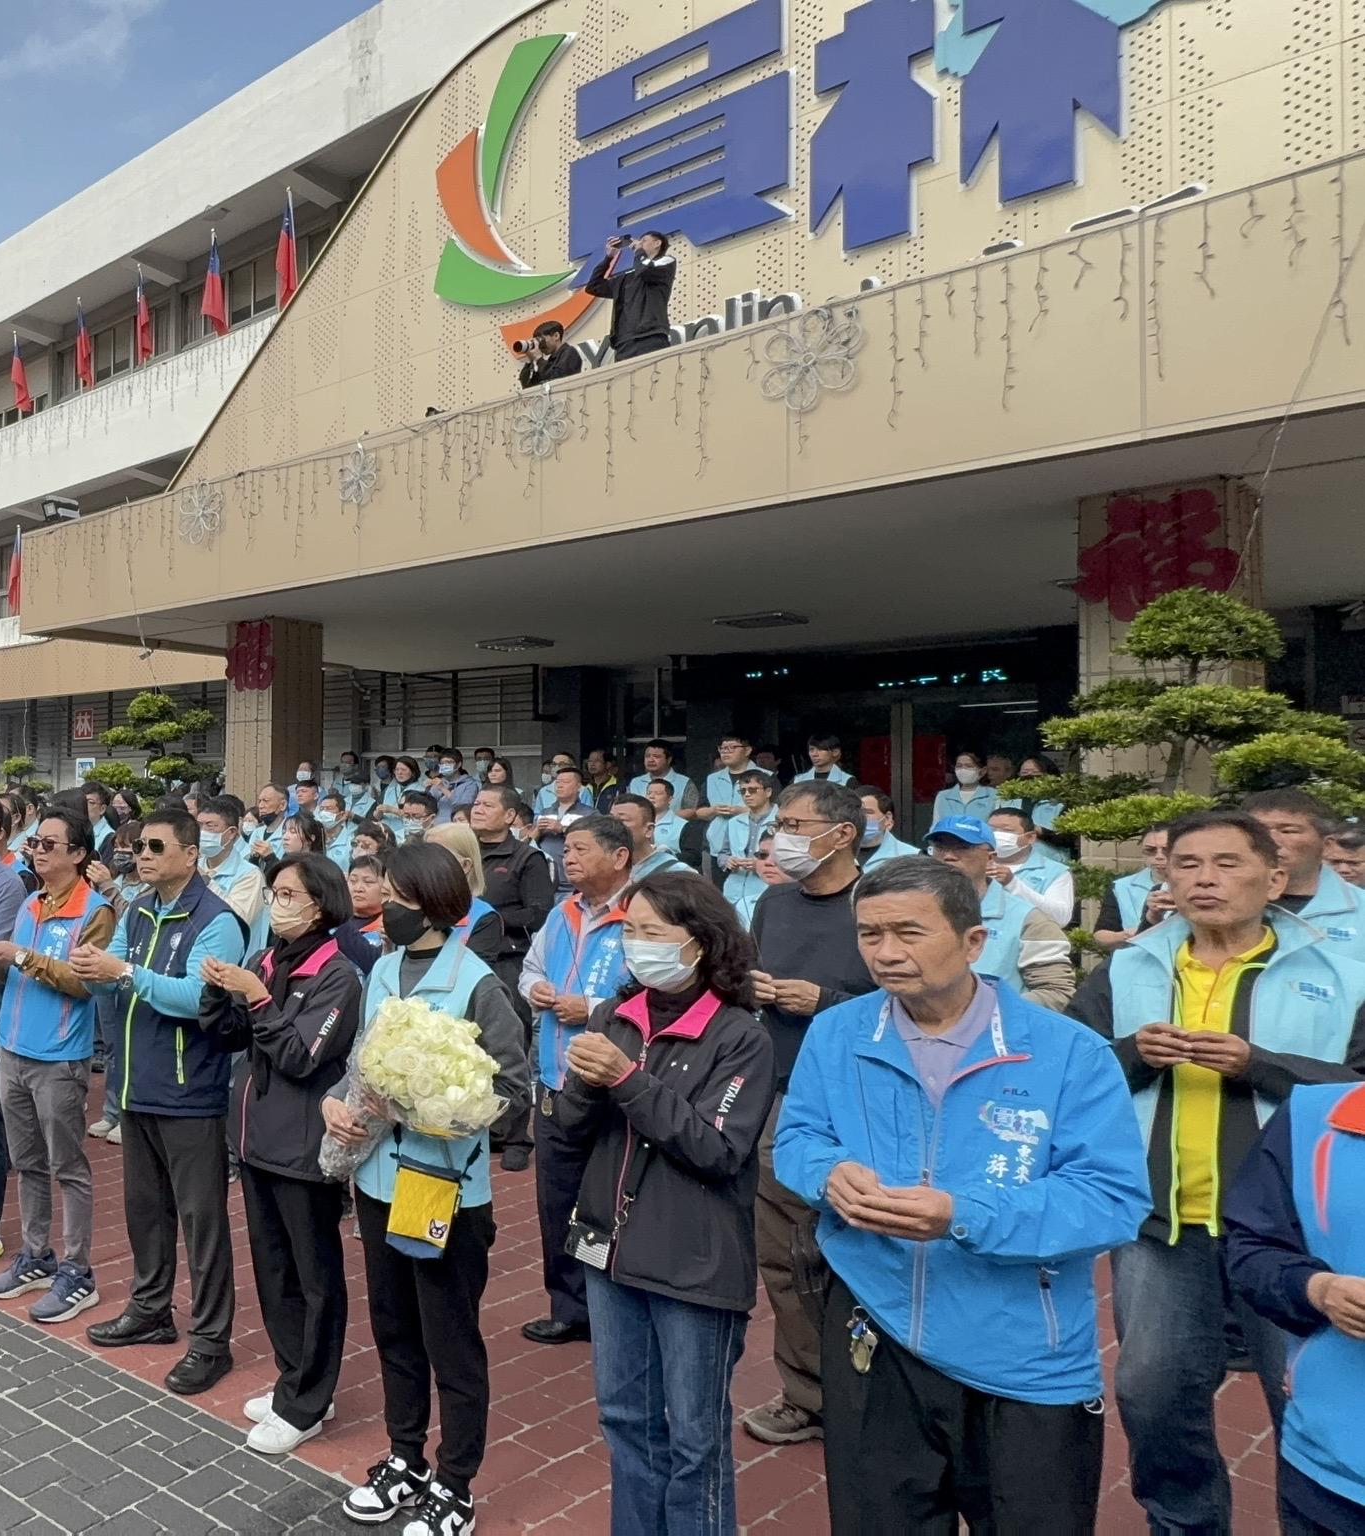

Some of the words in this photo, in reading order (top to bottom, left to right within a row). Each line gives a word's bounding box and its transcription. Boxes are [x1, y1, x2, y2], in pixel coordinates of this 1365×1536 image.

[569, 0, 1121, 290] 員林
[577, 290, 800, 371] Ynlin
[76, 711, 91, 736] 林
[717, 1082, 742, 1113] ITALIA
[1002, 1087, 1030, 1097] FILA
